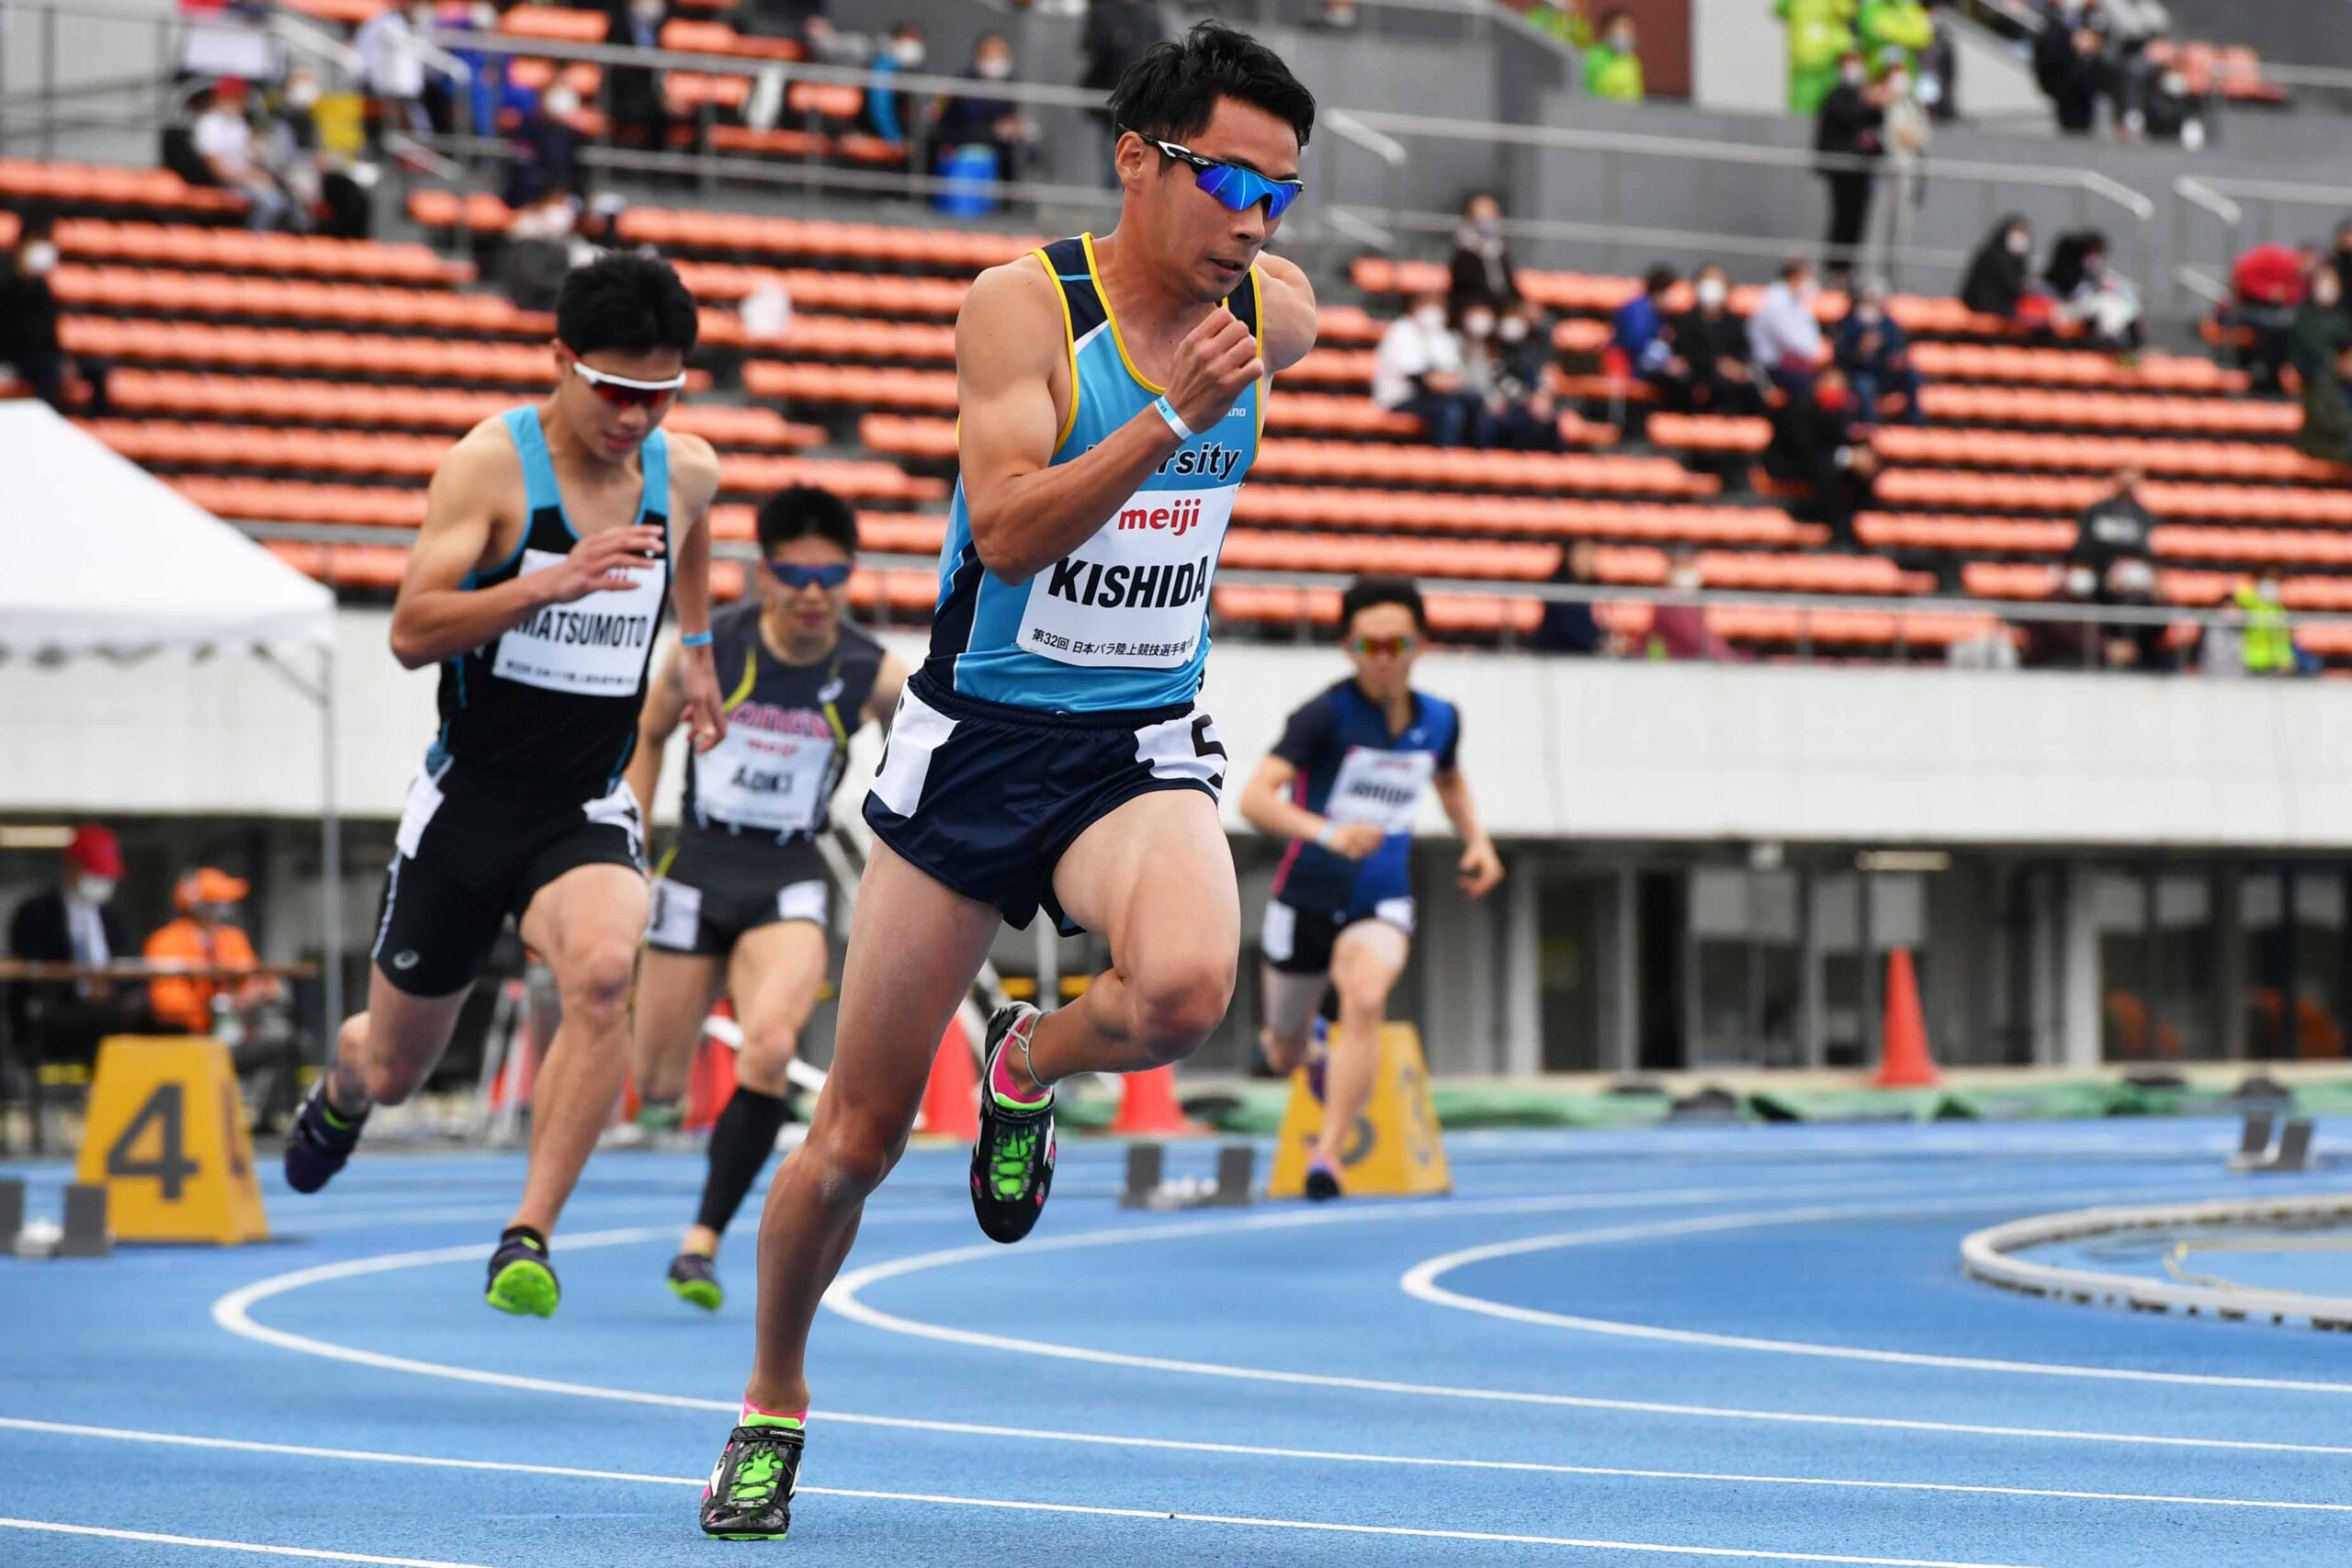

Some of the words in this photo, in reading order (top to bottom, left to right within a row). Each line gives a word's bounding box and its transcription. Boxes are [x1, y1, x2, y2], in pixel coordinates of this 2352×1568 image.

[1117, 498, 1202, 536] meiji
[1047, 555, 1208, 609] KISHIDA
[1031, 627, 1070, 651] 第32回
[107, 1082, 199, 1201] 4
